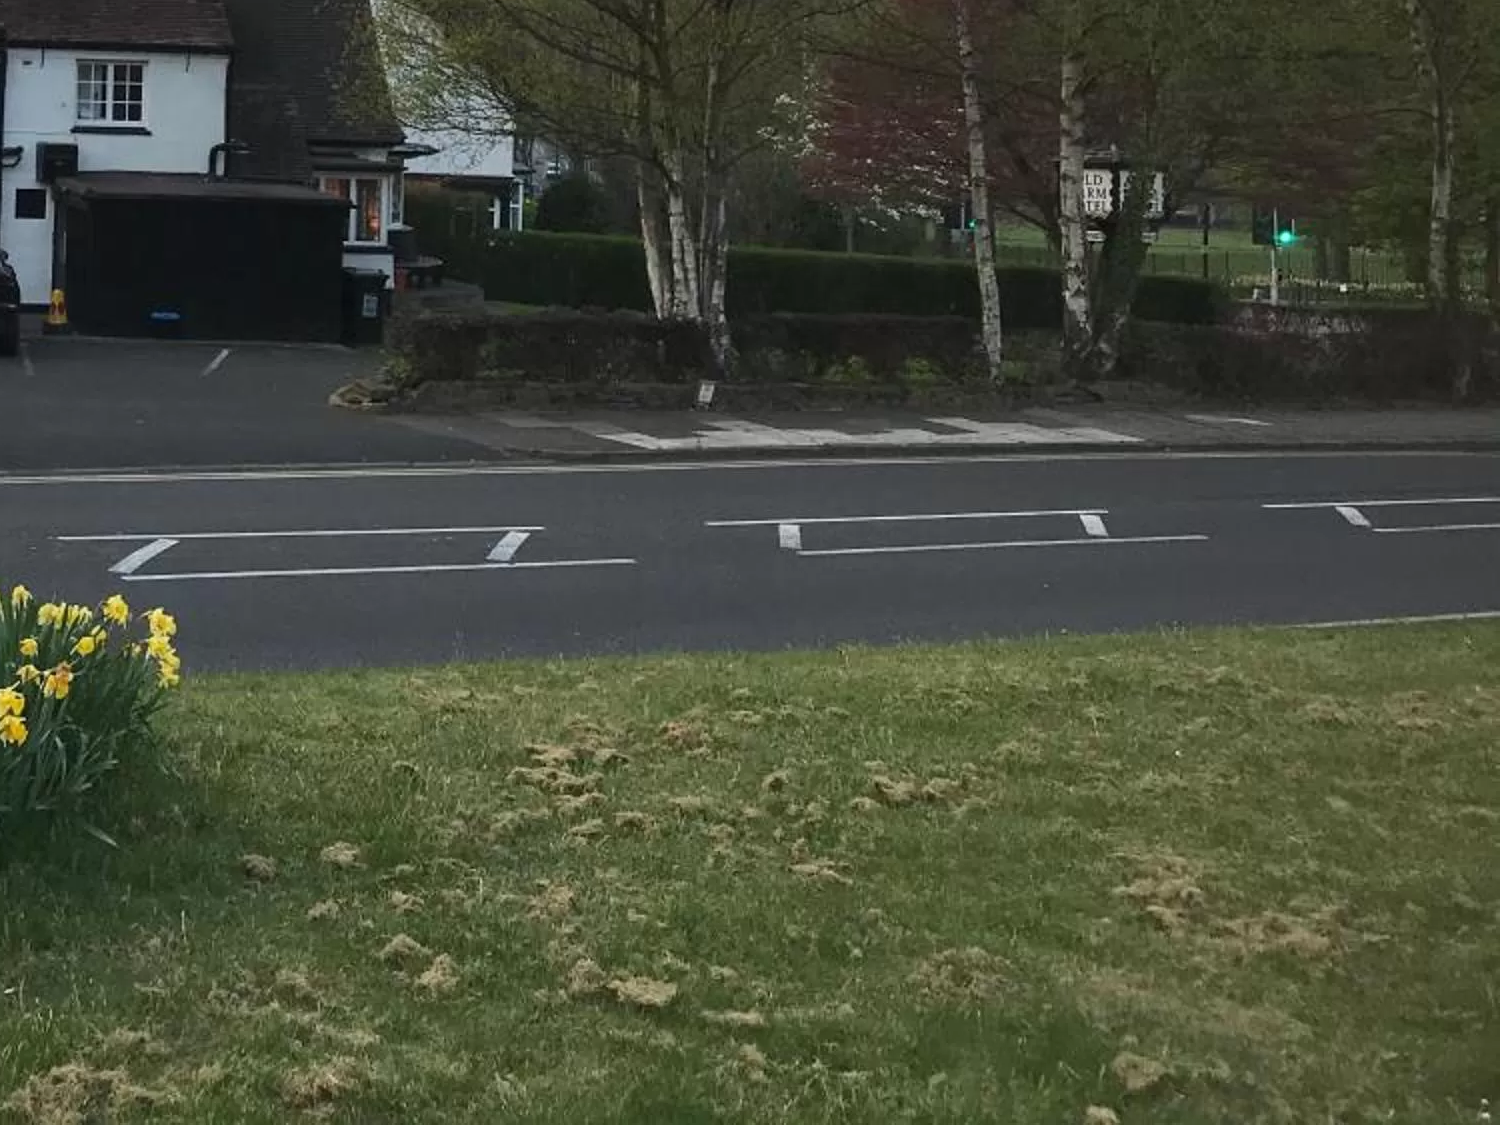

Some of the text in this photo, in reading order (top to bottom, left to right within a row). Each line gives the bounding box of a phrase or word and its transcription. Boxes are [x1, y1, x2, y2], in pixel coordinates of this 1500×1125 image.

[1085, 174, 1103, 185] LD
[1086, 187, 1107, 199] RM
[1085, 201, 1108, 212] TEL
